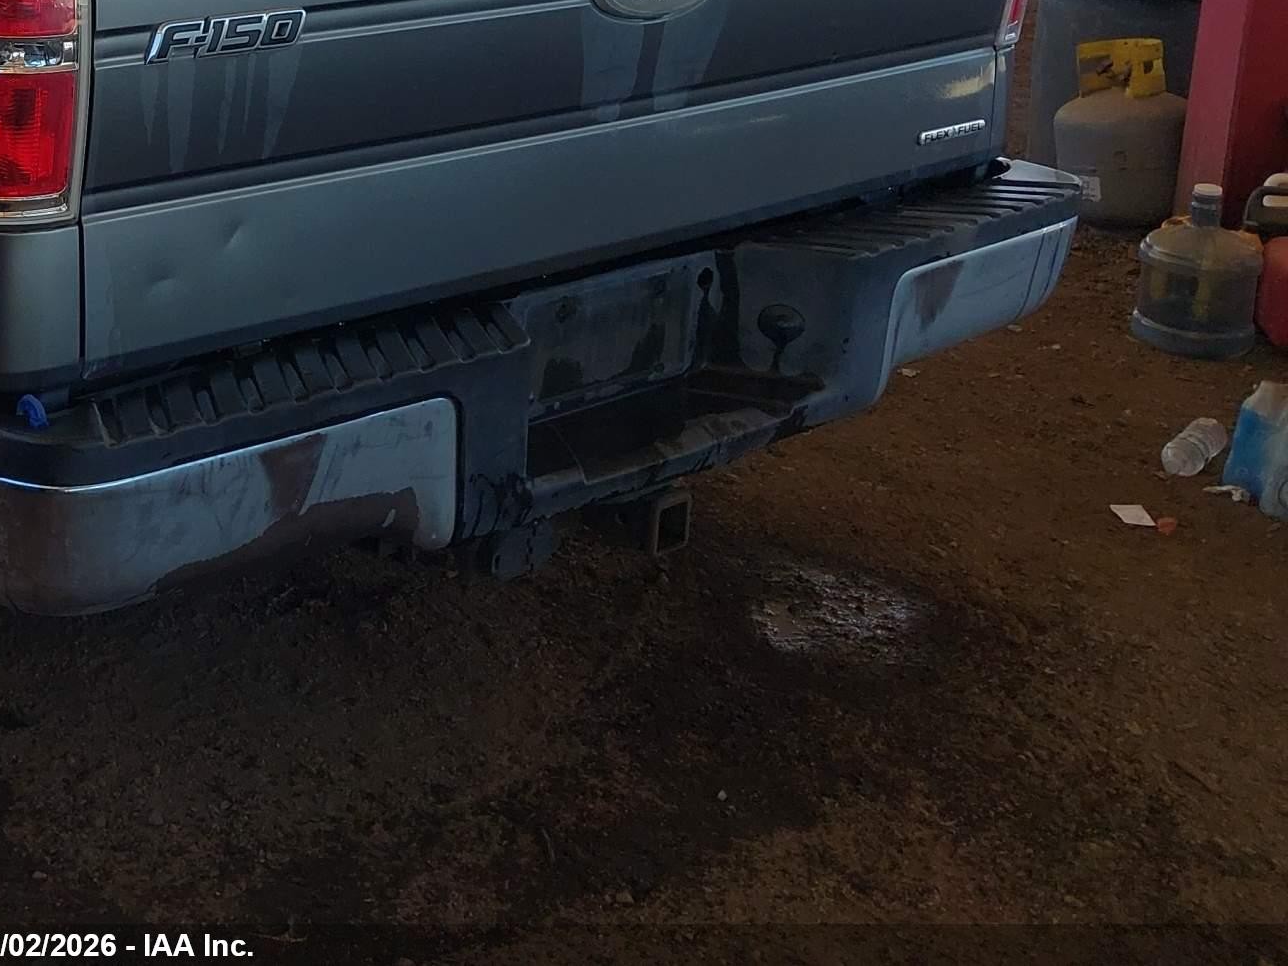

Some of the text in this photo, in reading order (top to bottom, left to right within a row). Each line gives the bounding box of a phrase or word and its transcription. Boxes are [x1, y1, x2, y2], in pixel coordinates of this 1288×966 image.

[145, 9, 306, 65] F-150
[924, 122, 984, 143] FLEX FUEL
